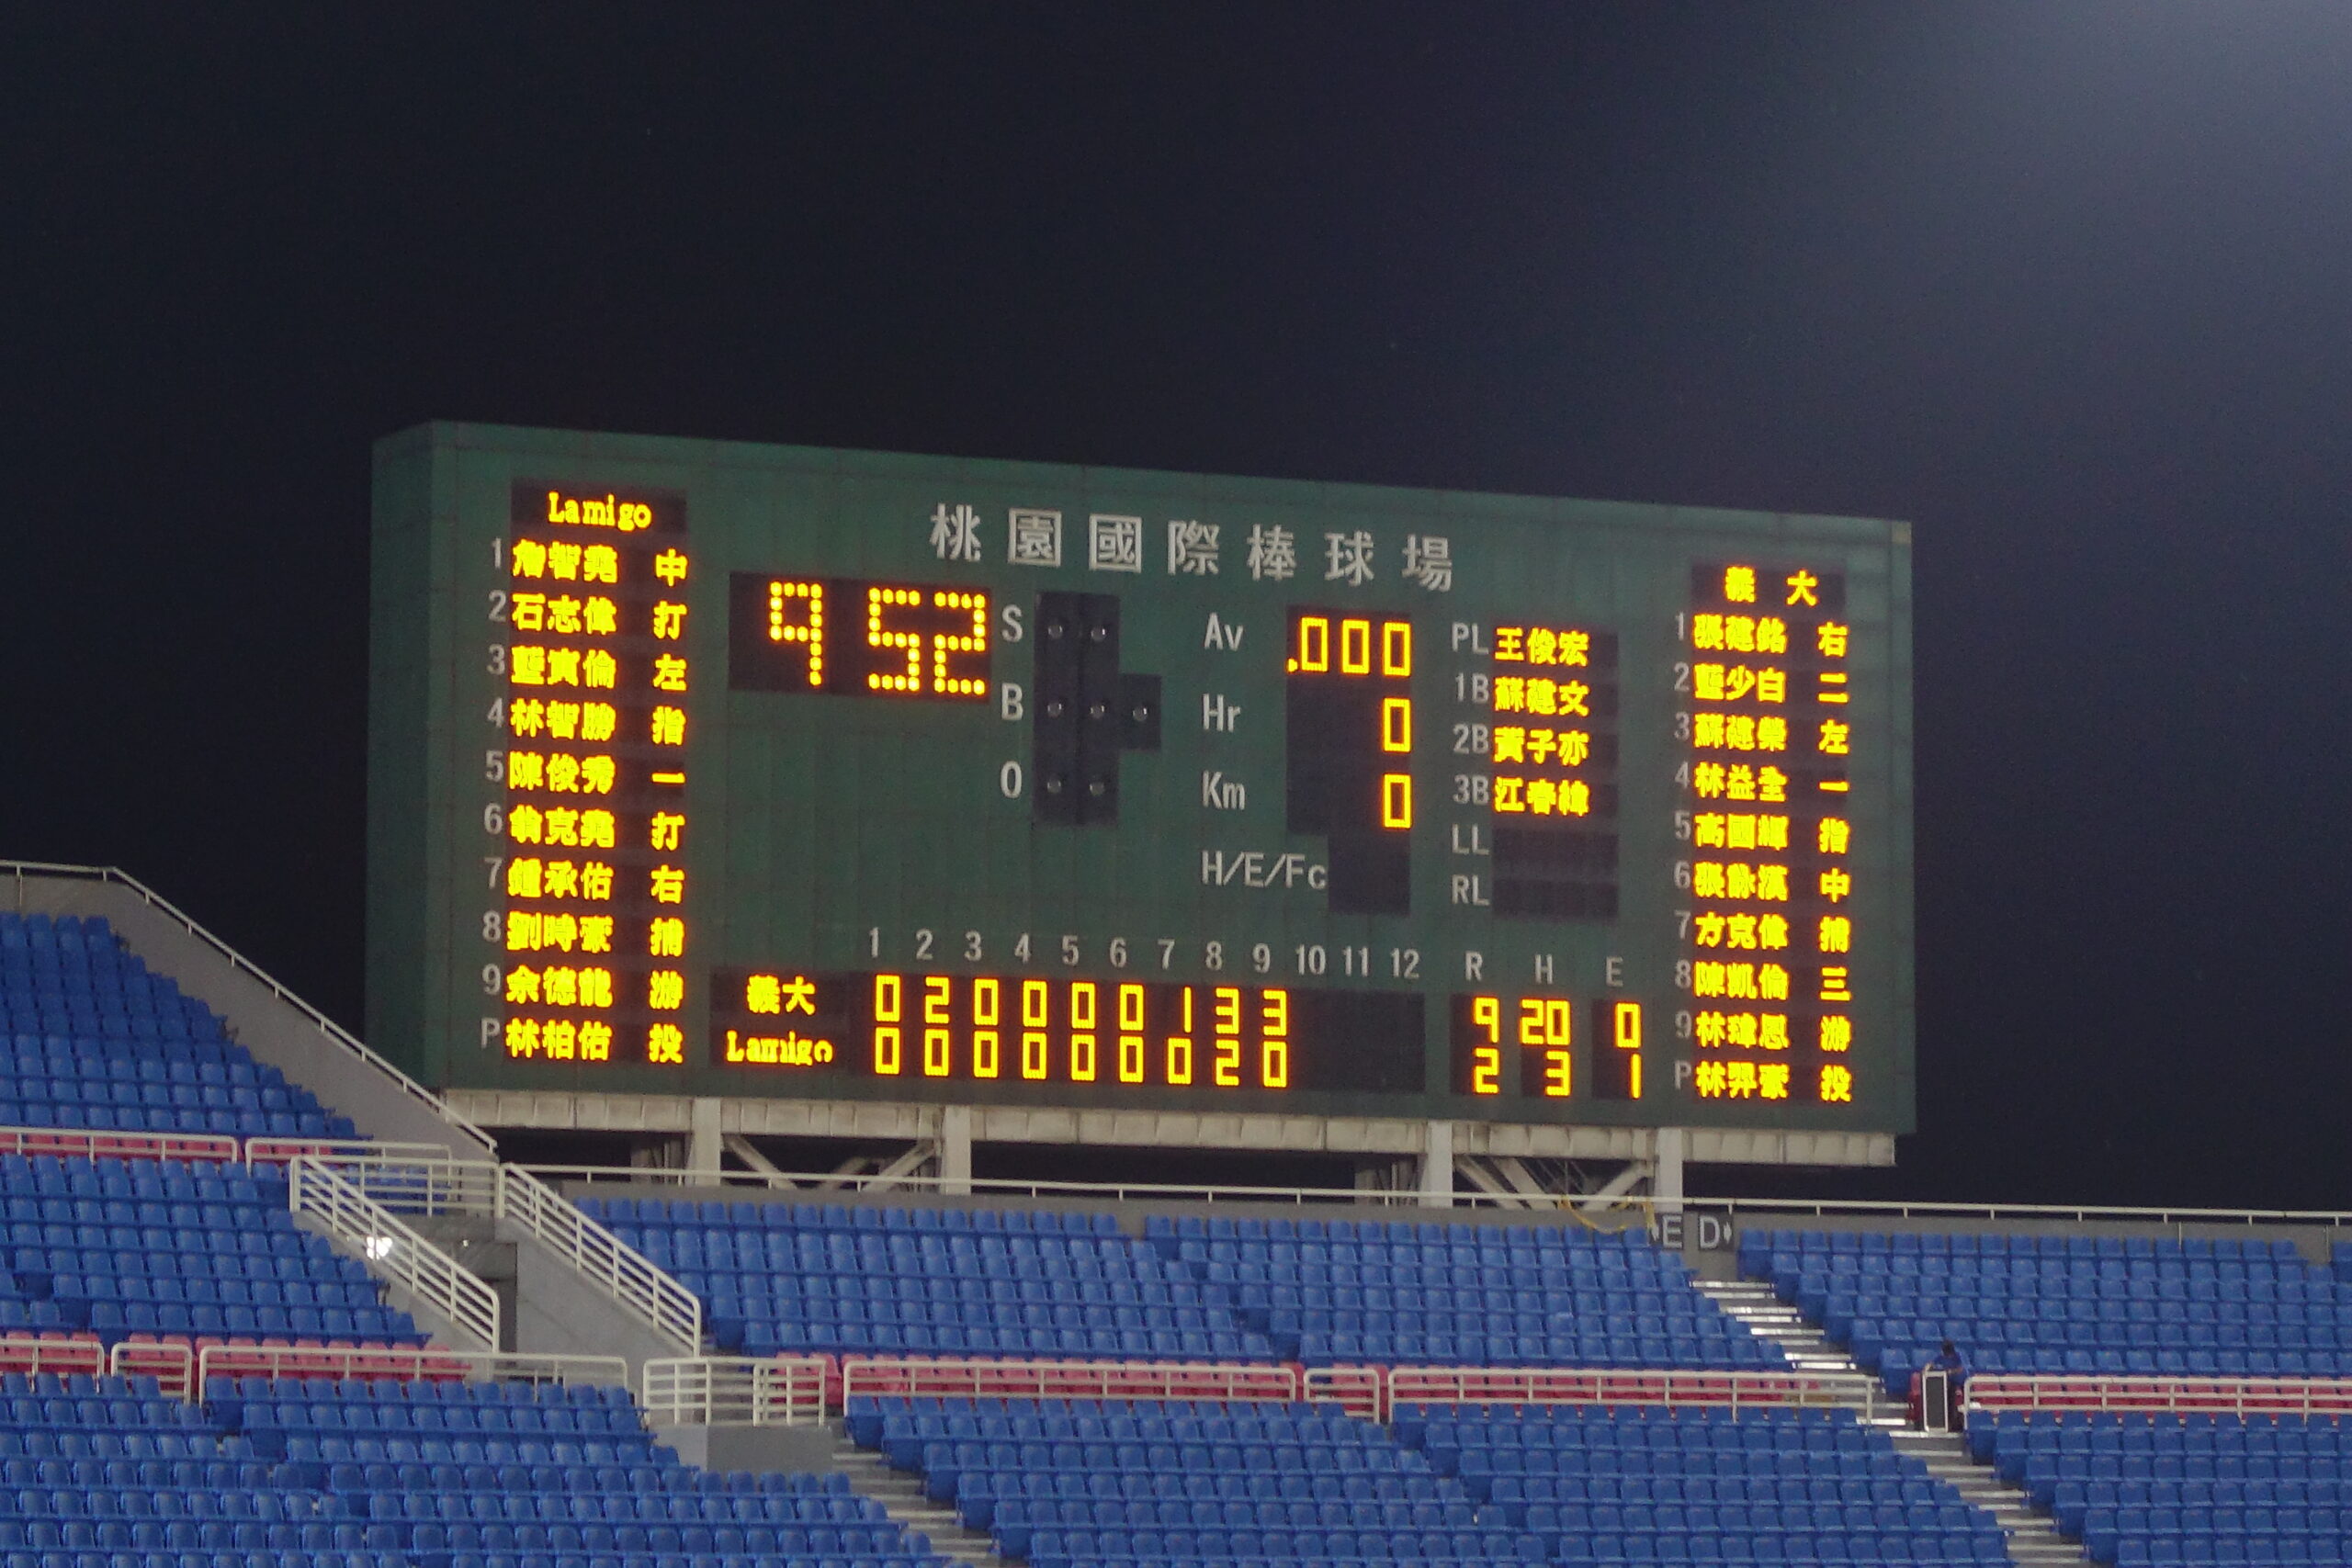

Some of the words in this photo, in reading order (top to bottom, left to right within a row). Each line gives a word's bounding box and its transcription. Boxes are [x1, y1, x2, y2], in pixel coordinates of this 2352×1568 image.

[548, 491, 651, 531] Lamigo
[492, 537, 502, 570] 1
[655, 548, 688, 587] 中
[929, 502, 1453, 592] 桃園國際棒球場
[489, 590, 506, 623] 2
[512, 593, 616, 635] 石志偉
[653, 601, 687, 639] 打
[1001, 604, 1023, 643] S
[1204, 613, 1244, 651] Av
[1675, 612, 1684, 641] 1
[1817, 621, 1849, 657] 右
[769, 581, 823, 685] 9
[867, 587, 986, 695] 52
[1452, 622, 1489, 655] PL
[487, 644, 505, 675] 3
[652, 653, 686, 691] 左
[1454, 672, 1489, 704] 1B
[1674, 663, 1690, 692] 2
[1817, 673, 1849, 704] 二
[487, 698, 503, 728] 4
[651, 705, 686, 745] 指
[1001, 683, 1023, 722] B
[1203, 694, 1240, 733] Hr
[1382, 698, 1411, 752] 0
[1453, 724, 1489, 755] 2B
[1674, 713, 1690, 740] 3
[1818, 719, 1849, 754] 左
[486, 750, 504, 781] 5
[651, 773, 685, 784] 一
[1675, 761, 1689, 789] 4
[1694, 761, 1788, 802] 林益全
[1819, 782, 1849, 792] 一
[1202, 771, 1246, 811] Km
[1383, 773, 1412, 829] 0
[1453, 774, 1489, 806] 3B
[484, 803, 503, 833] 6
[650, 811, 685, 851] 打
[1452, 823, 1490, 855] LL
[1674, 811, 1690, 840] 5
[1818, 818, 1851, 853] 指
[484, 858, 503, 889] 7
[650, 864, 684, 904] 右
[1202, 851, 1328, 890] H/E/Fc
[1452, 874, 1490, 906] RL
[1674, 861, 1690, 889] 6
[1820, 867, 1851, 903] 中
[483, 910, 502, 942] 8
[650, 918, 684, 956] 捕
[1674, 911, 1690, 939] 7
[1819, 916, 1851, 953] 捕
[870, 927, 879, 958] 1
[916, 930, 933, 960] 2
[965, 931, 983, 963] 3
[1014, 932, 1032, 964] 4
[1062, 935, 1080, 966] 5
[1109, 937, 1127, 968] 6
[1158, 939, 1176, 970] 7
[1205, 941, 1223, 972] 8
[1253, 942, 1271, 974] 9
[1295, 944, 1326, 976] 10
[1342, 945, 1370, 977] 11
[1391, 948, 1419, 979] 12
[1465, 952, 1483, 981] R
[1535, 954, 1554, 984] H
[1606, 956, 1623, 987] E
[482, 964, 501, 995] 9
[650, 970, 684, 1010] 游
[1675, 960, 1691, 988] 8
[1820, 966, 1852, 1001] 三
[876, 975, 900, 1022] 0
[925, 976, 950, 1023] 2
[974, 978, 999, 1026] 0
[1023, 980, 1047, 1027] 0
[1071, 983, 1095, 1029] 0
[1119, 984, 1144, 1031] 0
[1183, 987, 1192, 1032] 1
[1216, 987, 1239, 1034] 3
[1263, 989, 1287, 1036] 3
[1474, 998, 1499, 1043] 9
[1519, 999, 1571, 1045] 20
[1615, 1003, 1641, 1048] 0
[1675, 1011, 1691, 1039] 9
[1820, 1016, 1851, 1052] 游
[481, 1018, 501, 1048] P
[649, 1023, 683, 1063] 投
[727, 1031, 832, 1066] Lamigo
[875, 1027, 900, 1075] 0
[924, 1029, 949, 1076] 0
[974, 1031, 999, 1077] 0
[1023, 1032, 1046, 1079] 0
[1070, 1034, 1095, 1081] 0
[1119, 1035, 1144, 1083] 0
[1167, 1038, 1192, 1084] 0
[1215, 1039, 1239, 1086] 2
[1262, 1041, 1287, 1088] 0
[1474, 1048, 1499, 1093] 2
[1545, 1051, 1571, 1096] 3
[1631, 1054, 1641, 1099] 1
[1675, 1061, 1691, 1089] P
[1820, 1065, 1851, 1101] 投
[1663, 1214, 1683, 1249] E
